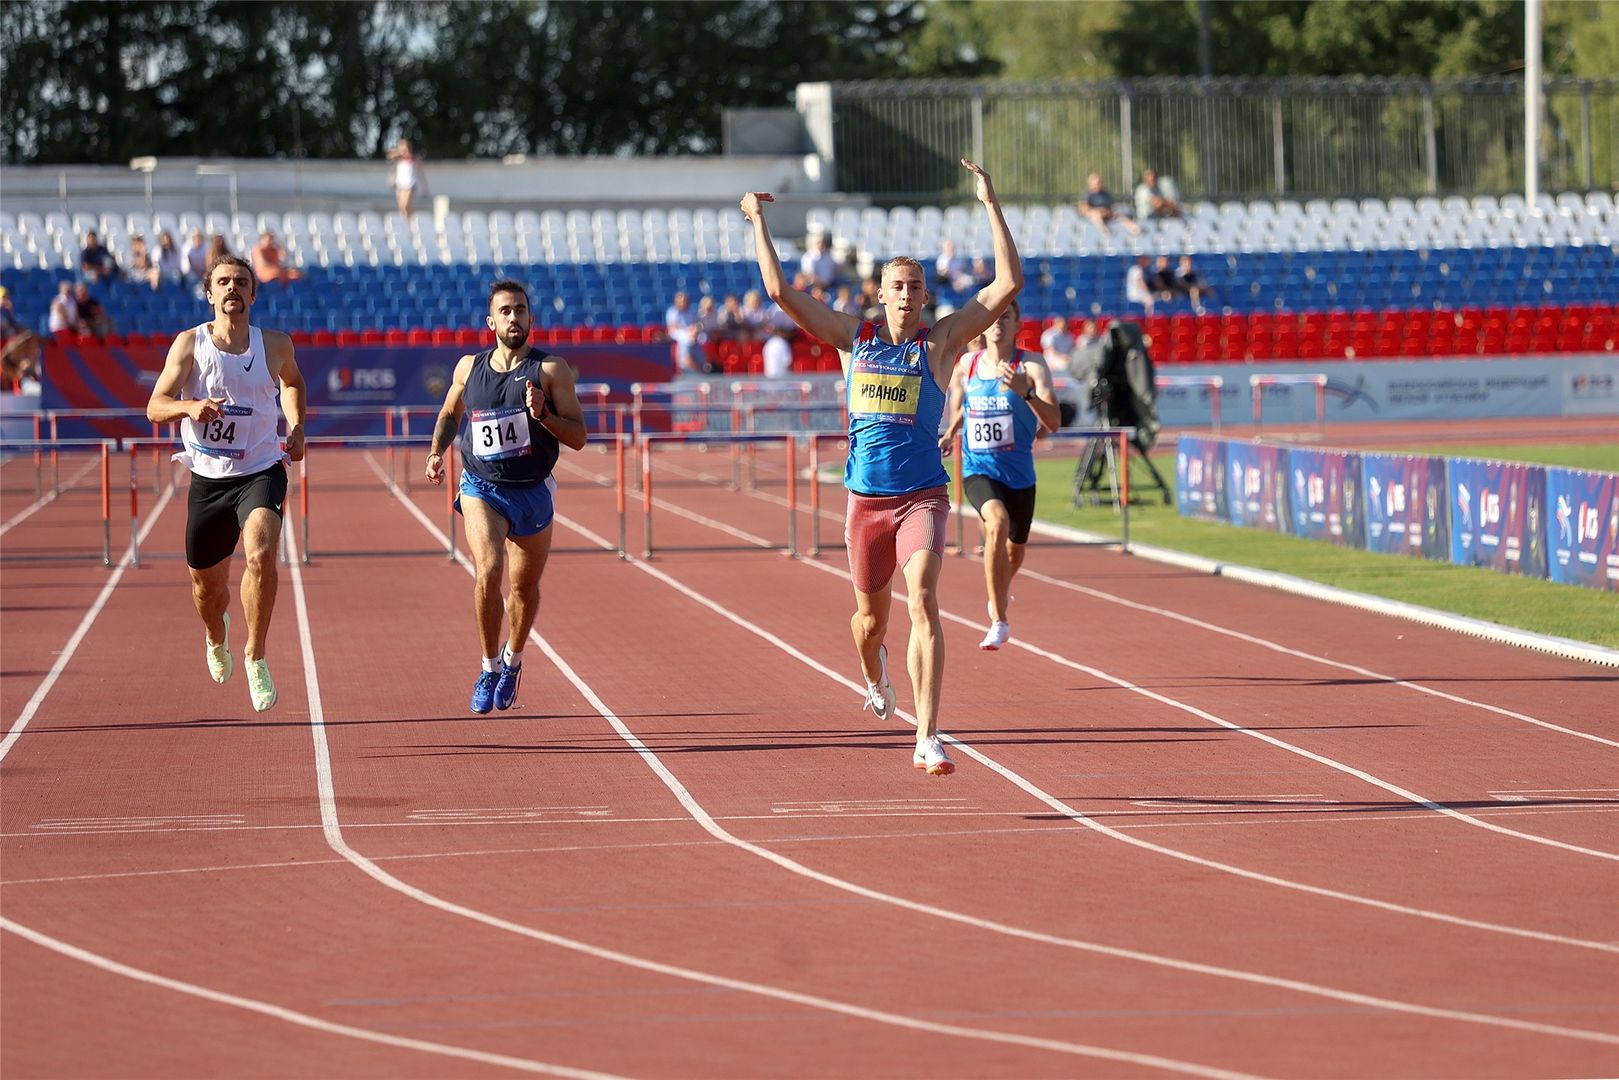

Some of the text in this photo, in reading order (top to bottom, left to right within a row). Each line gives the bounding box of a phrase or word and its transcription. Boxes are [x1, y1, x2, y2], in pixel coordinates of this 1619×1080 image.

[861, 384, 907, 403] ИВАНОВ
[203, 419, 236, 444] 134
[482, 421, 518, 448] 314
[974, 422, 1002, 442] 836
